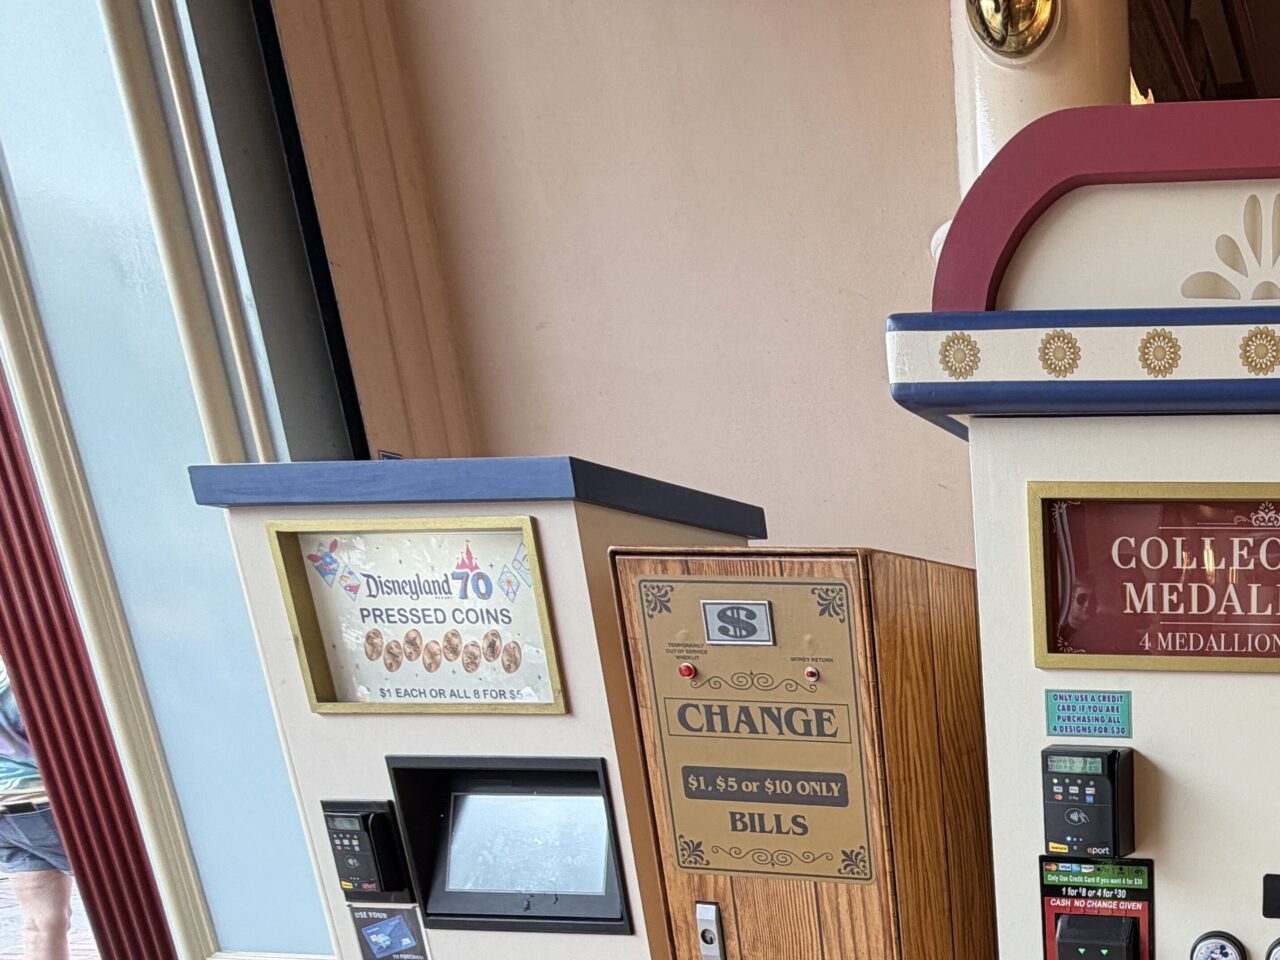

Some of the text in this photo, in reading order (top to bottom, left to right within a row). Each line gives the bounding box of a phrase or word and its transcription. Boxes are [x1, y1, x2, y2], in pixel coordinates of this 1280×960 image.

[360, 570, 493, 600] Disneyland 70
[360, 607, 512, 625] PRESSED COINS
[716, 605, 758, 639] $
[1138, 632, 1152, 650] 4
[379, 687, 523, 700] $1 EACH OR ALL 8 FOR $5
[1053, 693, 1072, 701] ONLY
[1075, 694, 1088, 702] USE
[1057, 704, 1077, 712] CARD
[1088, 705, 1104, 713] YOU
[677, 702, 839, 738] CHANGE
[1057, 715, 1121, 724] PURCHASING ALL
[1094, 726, 1108, 734] FOR
[688, 774, 842, 797] $1, $5 or $10 ONLY
[728, 811, 809, 836] BILLS
[1087, 847, 1110, 855] eport
[1048, 874, 1059, 883] Only
[1061, 887, 1127, 898] 1 for $8 or 4 for $30
[1050, 899, 1071, 907] CASH
[1086, 900, 1117, 909] CHANGE
[1119, 902, 1143, 910] GIVEN
[354, 911, 368, 919] USE
